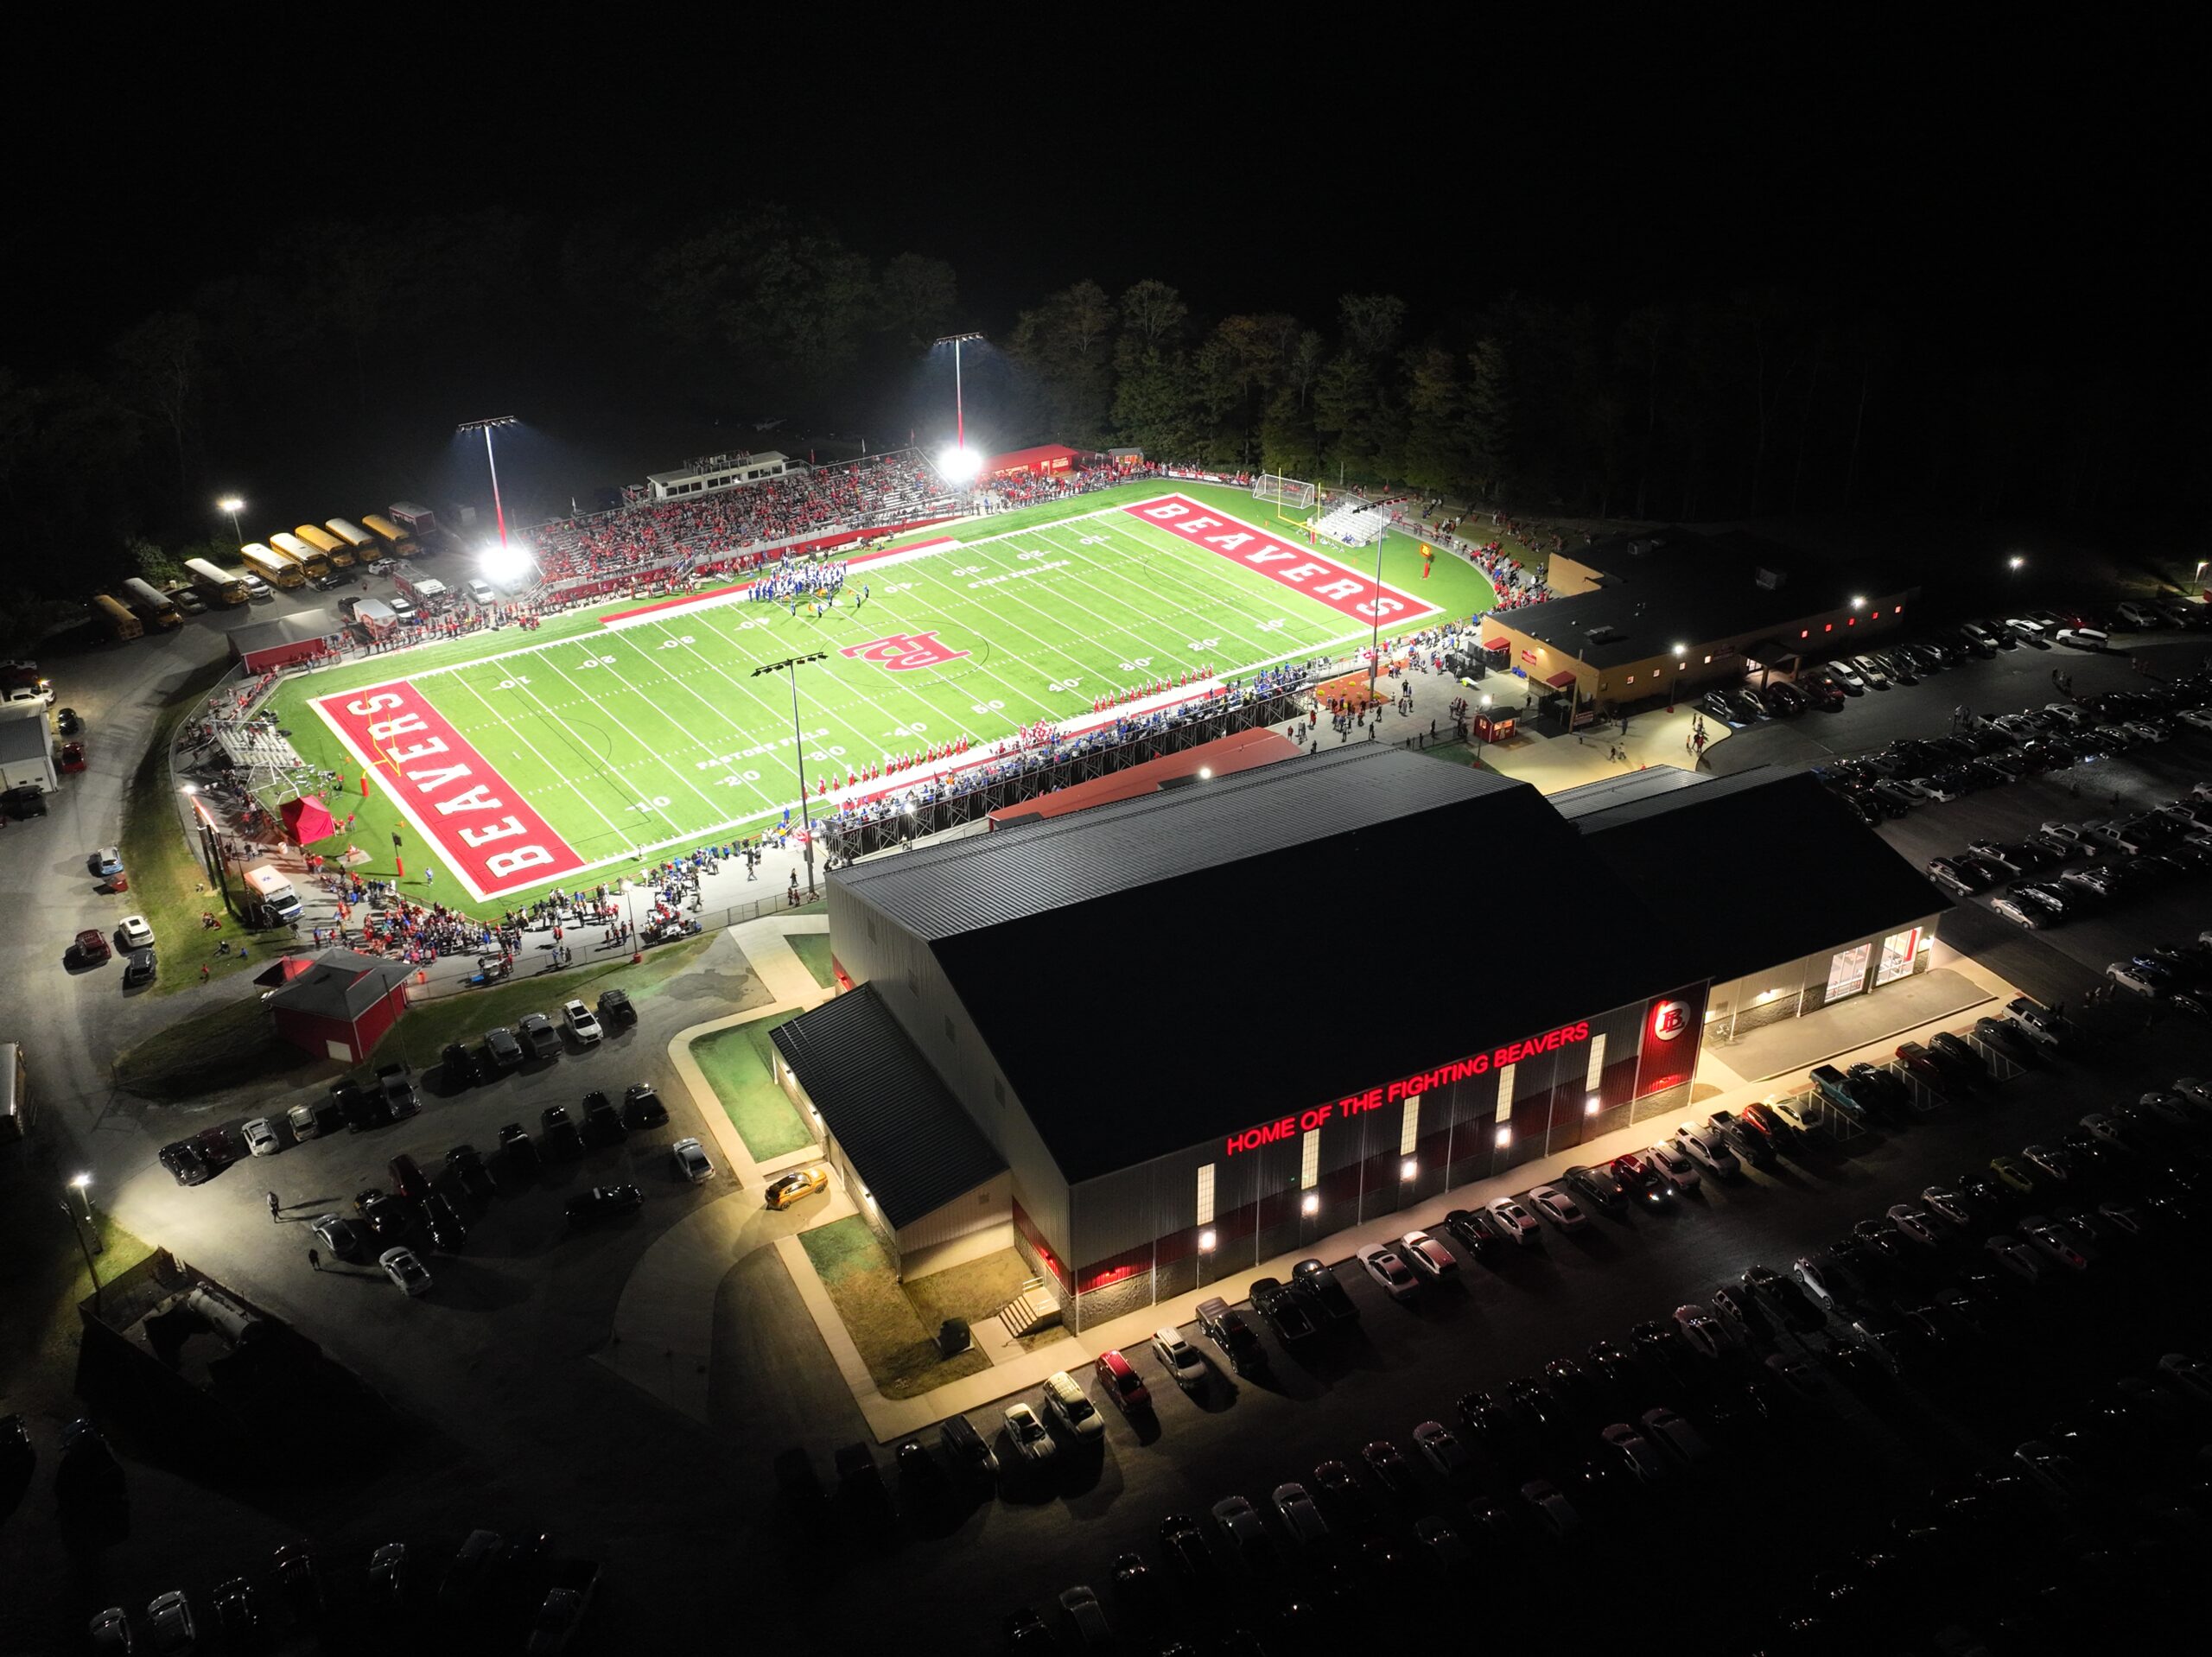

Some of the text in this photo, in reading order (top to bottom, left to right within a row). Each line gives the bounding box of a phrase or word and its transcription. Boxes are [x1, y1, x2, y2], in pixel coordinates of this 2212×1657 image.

[1144, 504, 1404, 617] BEAVERS
[741, 617, 771, 629] 40
[1256, 619, 1284, 632] 10
[663, 636, 696, 648] 30
[1187, 638, 1217, 651] 20
[583, 656, 617, 669] 20
[1118, 657, 1151, 671] 30
[500, 675, 532, 689] 10
[1048, 679, 1079, 692] 40
[970, 700, 1005, 714] 50
[894, 722, 927, 736] 40
[696, 742, 778, 771] PASTORE
[810, 746, 847, 761] 30
[346, 692, 555, 878] BEAVERS
[724, 771, 760, 787] 20
[633, 796, 671, 813] 10
[1227, 1021, 1590, 1156] HOME OF THE FIGHTING BEAVERS
